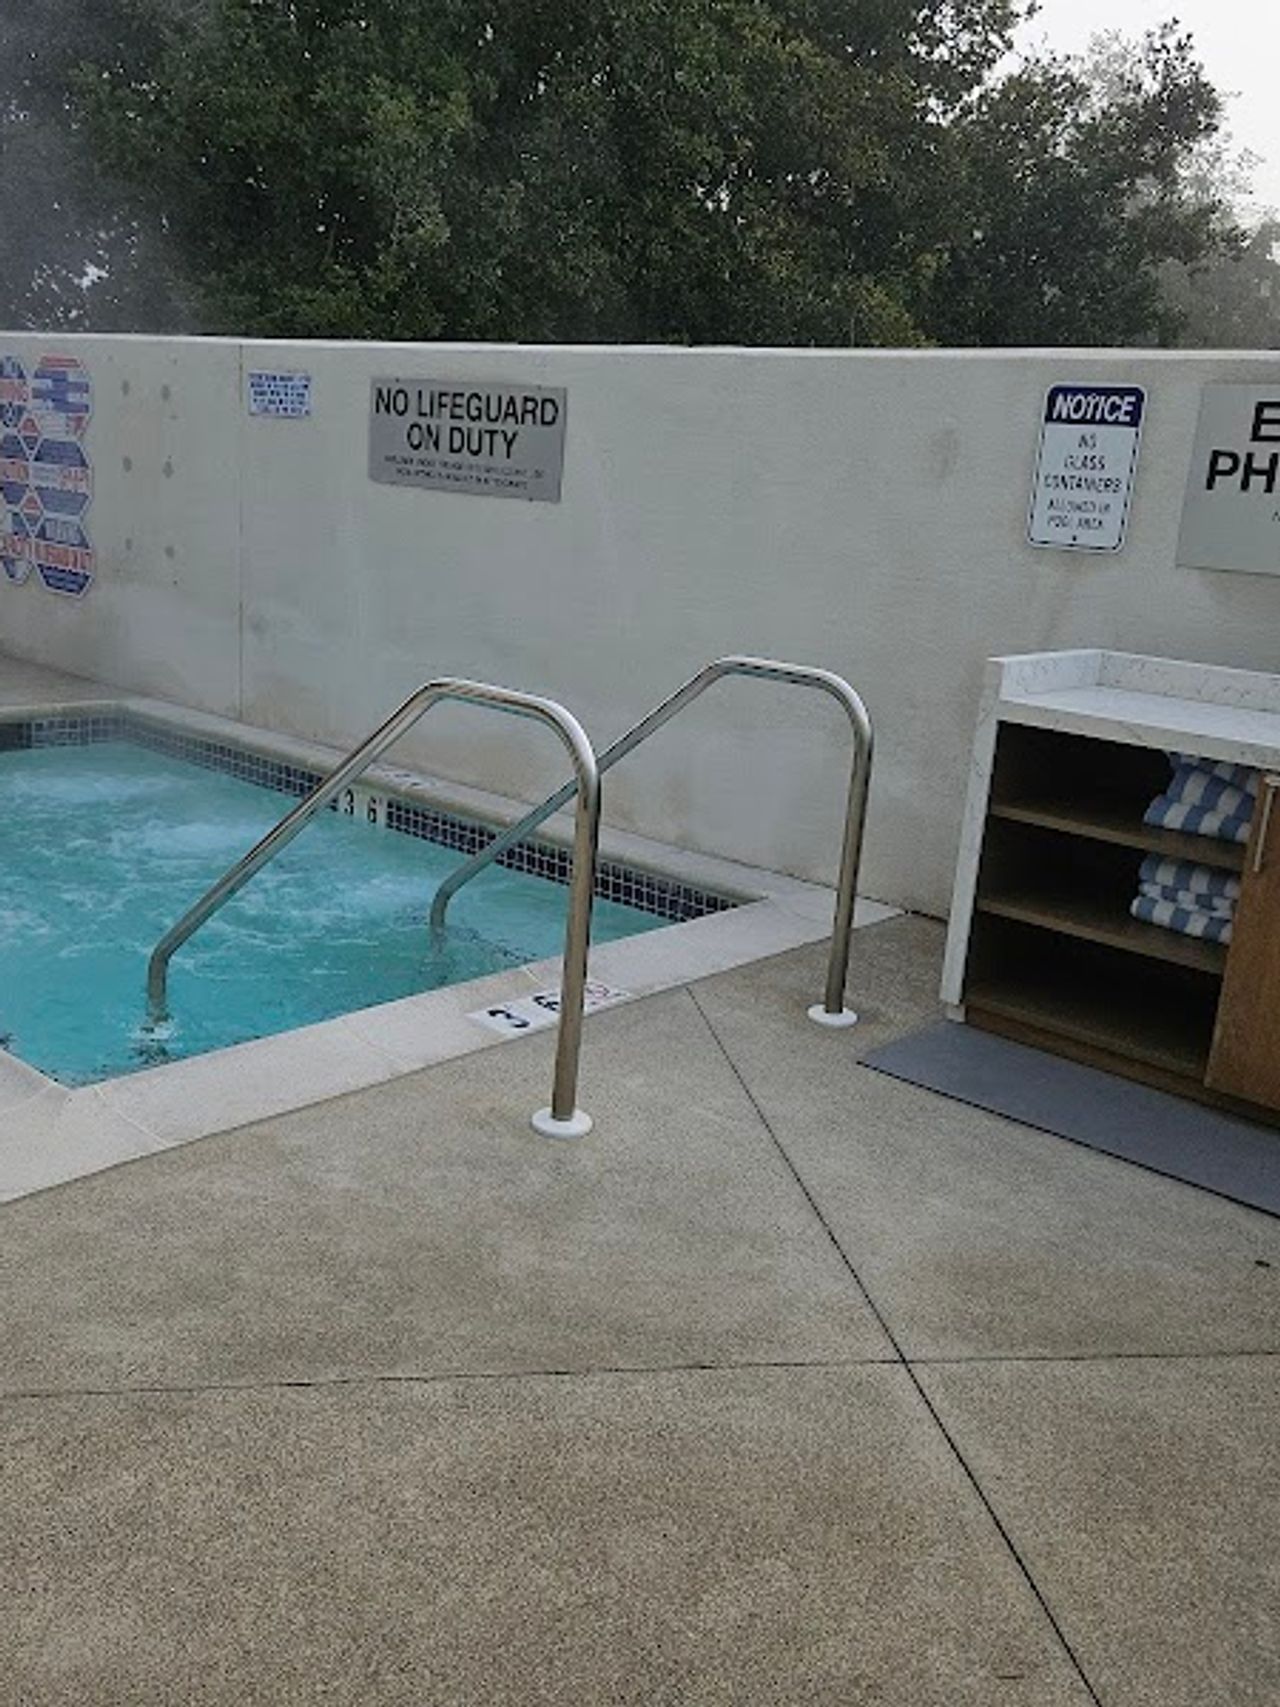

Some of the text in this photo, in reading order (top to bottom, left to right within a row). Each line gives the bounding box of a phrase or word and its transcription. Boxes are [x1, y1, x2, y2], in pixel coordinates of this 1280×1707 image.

[375, 387, 559, 426] NO LIFEGUARD
[1053, 392, 1137, 422] NOTICE
[406, 422, 518, 459] ON DUTY
[1063, 454, 1106, 471] GLASS
[1205, 449, 1279, 494] PH
[1043, 474, 1123, 494] CONTAINERS
